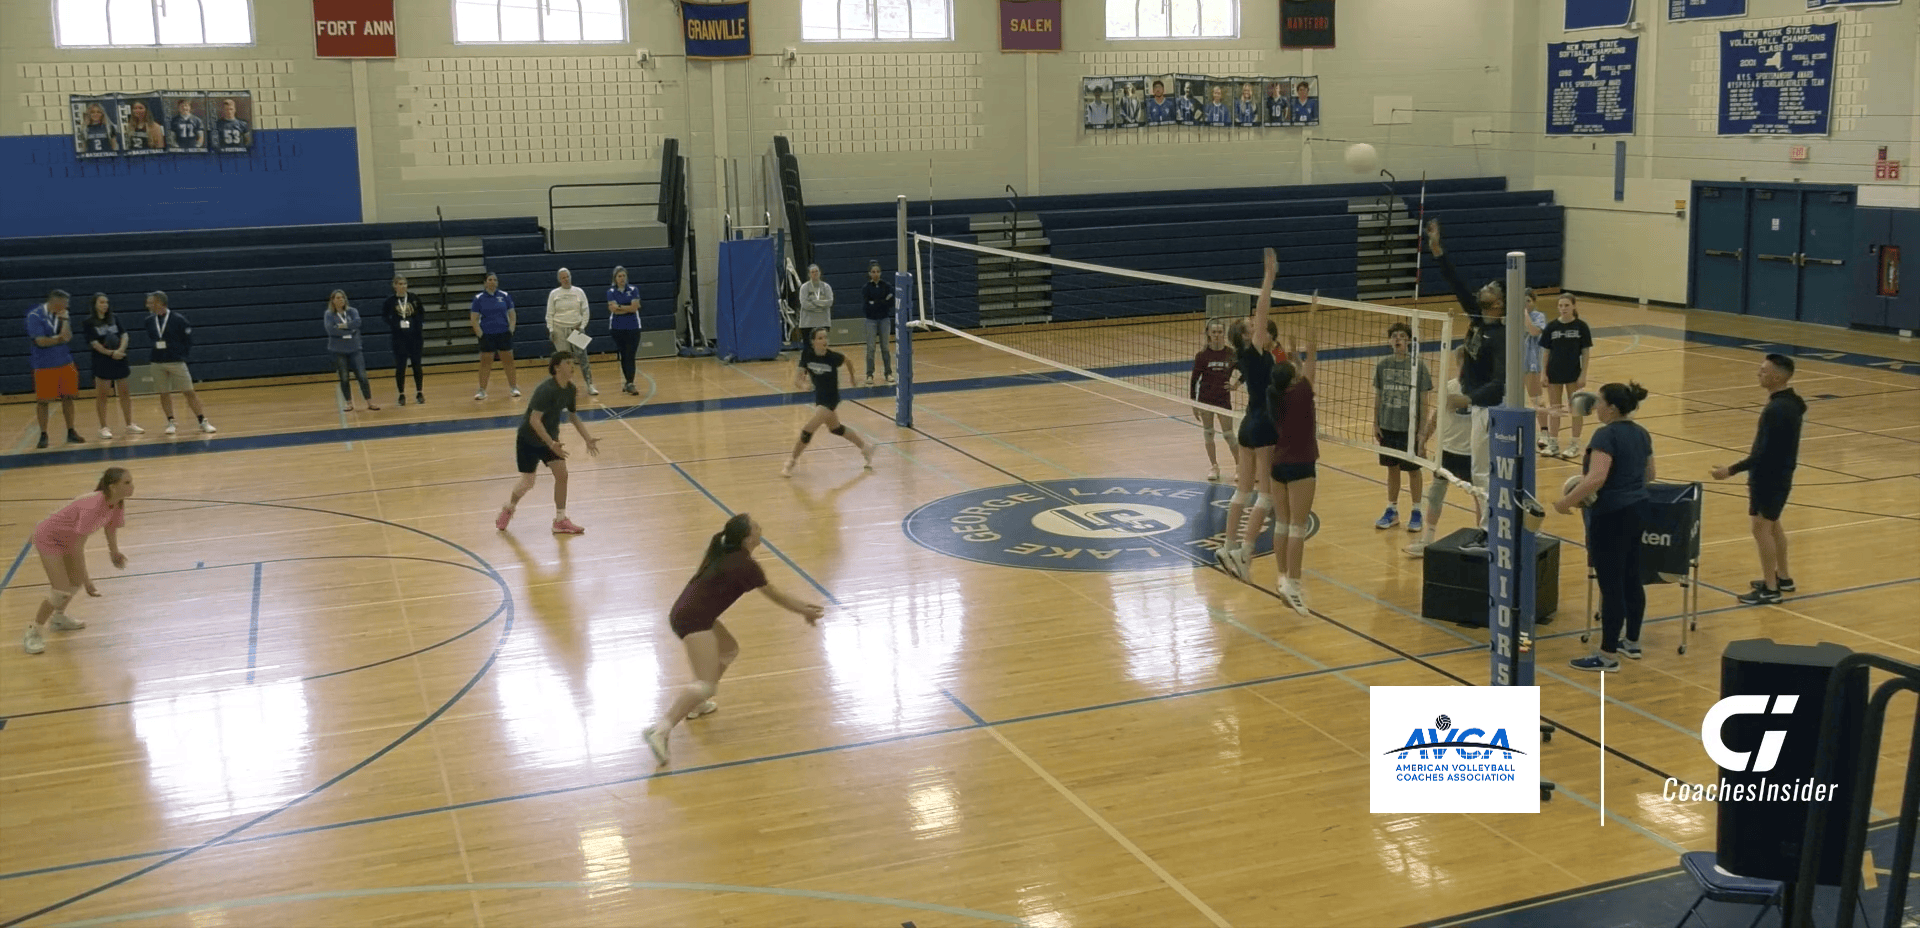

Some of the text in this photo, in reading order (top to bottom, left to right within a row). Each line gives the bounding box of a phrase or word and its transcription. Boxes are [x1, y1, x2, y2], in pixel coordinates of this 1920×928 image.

[316, 20, 394, 36] FORT ANN
[687, 18, 745, 41] GRANVILLE
[1010, 18, 1052, 32] SALEM
[1743, 26, 1811, 39] NEW YORK STATE
[1582, 42, 1597, 50] YORK
[1599, 40, 1619, 48] STATE
[1730, 33, 1826, 47] VOLLEYBALL CHAMPIONS
[1559, 46, 1626, 58] SOFTBALL CHAMPIONS
[1758, 44, 1784, 53] CLASS
[1578, 55, 1598, 63] CLASS
[1811, 78, 1825, 86] TEAM
[223, 129, 241, 144] 53
[1068, 486, 1205, 501] LAKE
[951, 492, 1161, 560] LAKE GEORGE
[1496, 455, 1515, 685] WARRIORS
